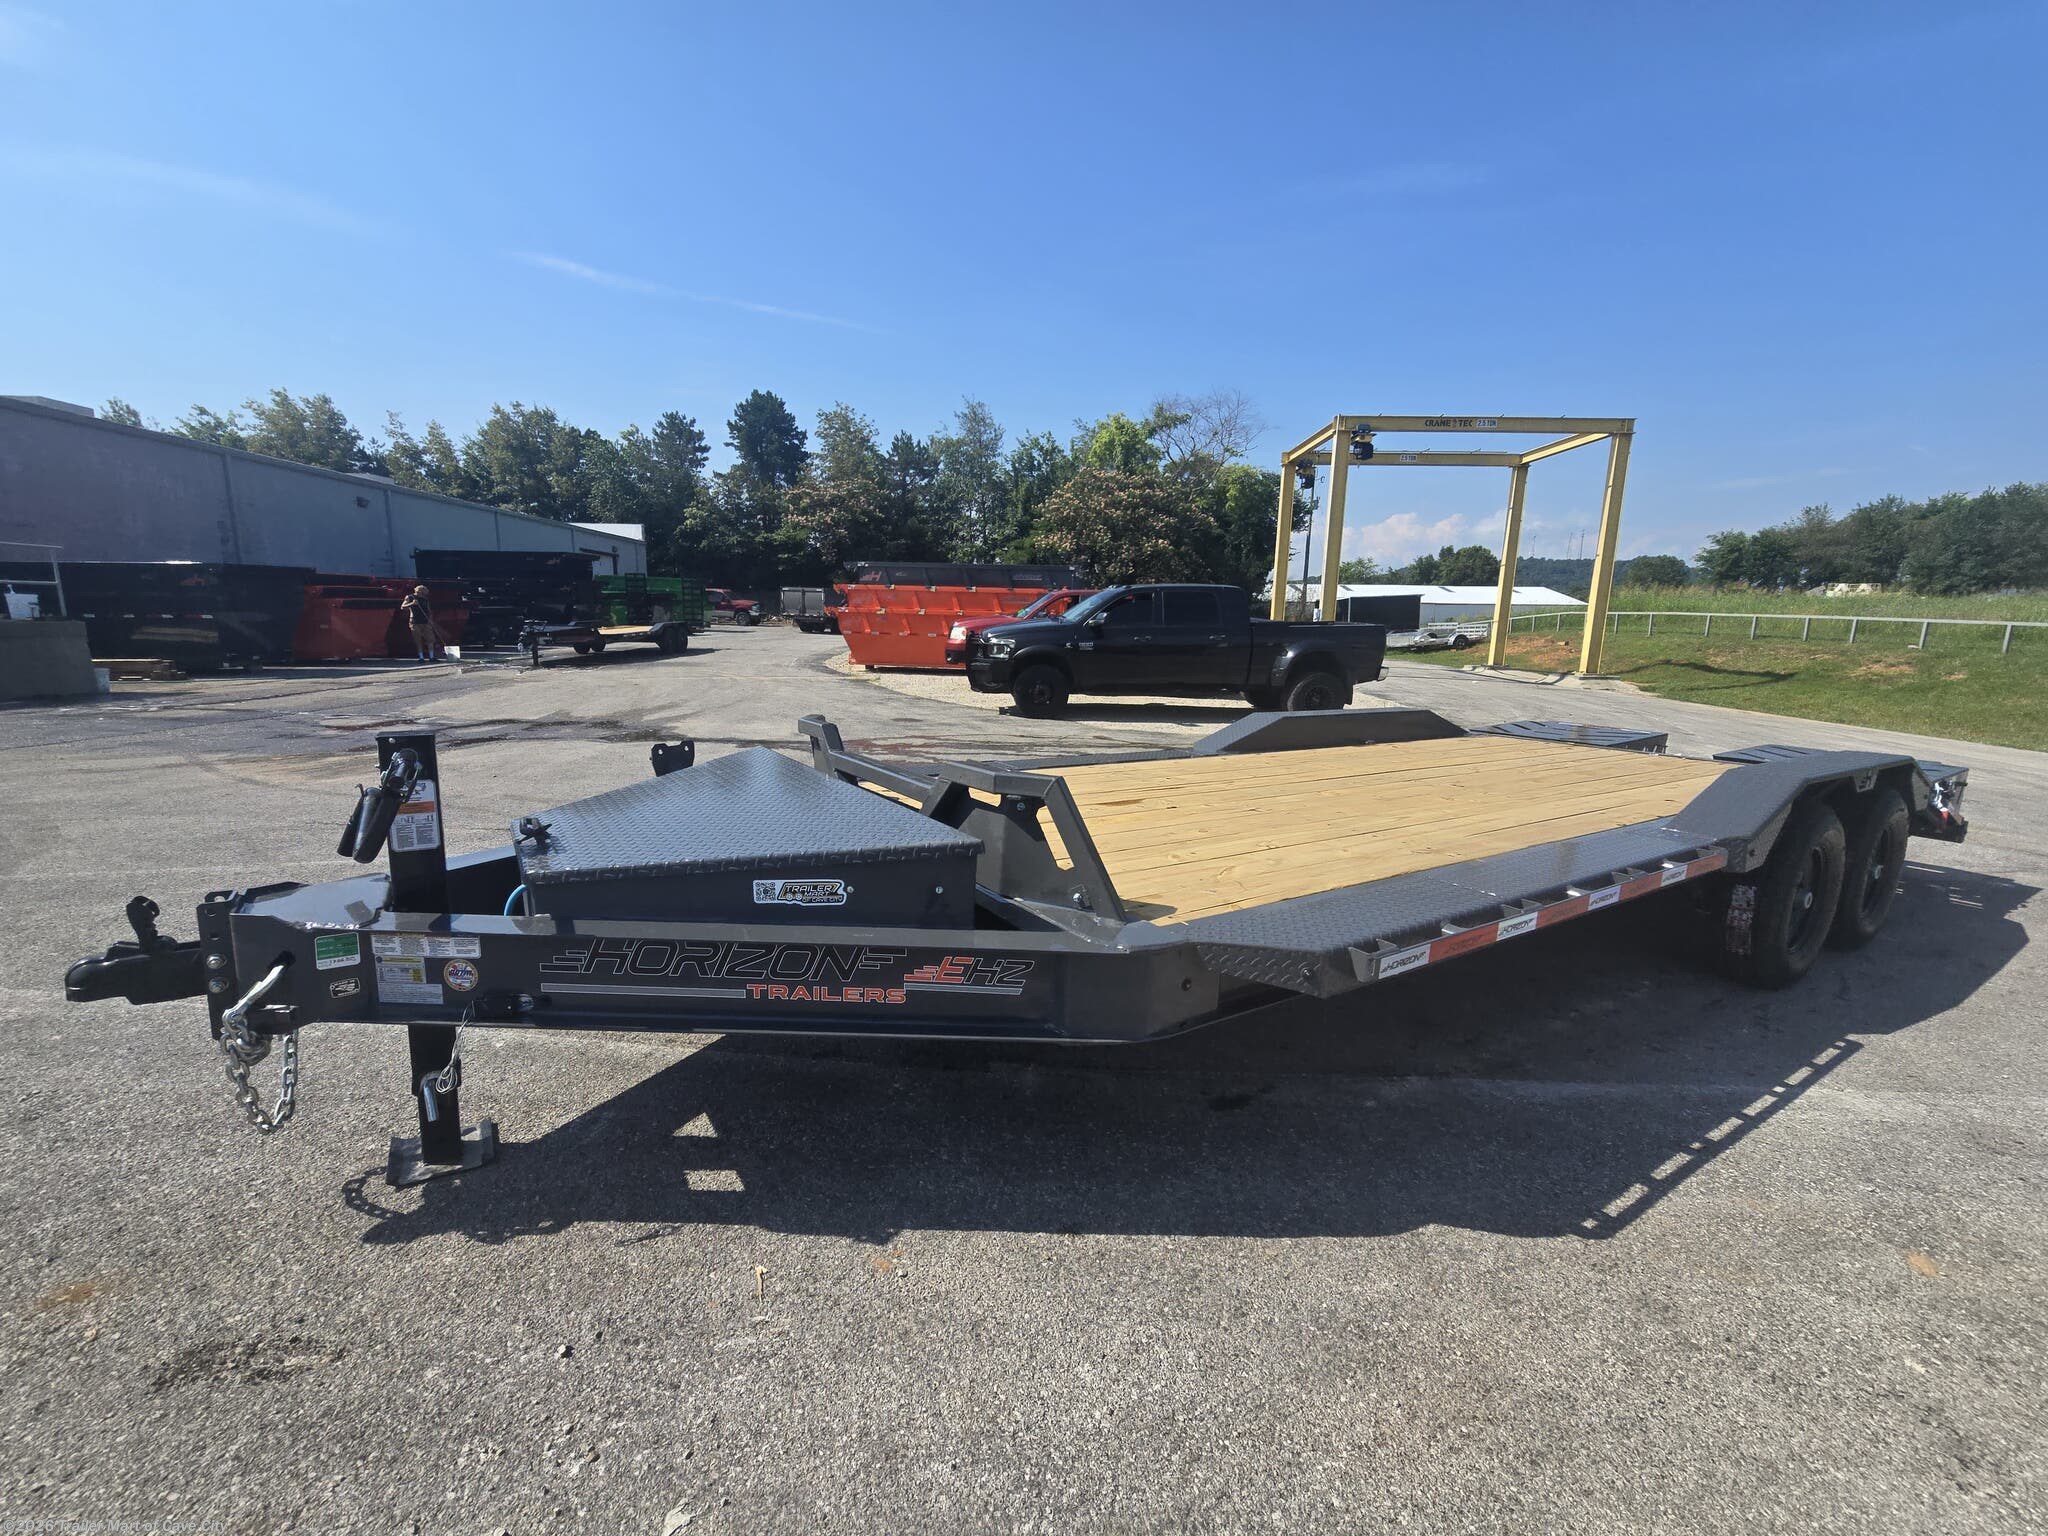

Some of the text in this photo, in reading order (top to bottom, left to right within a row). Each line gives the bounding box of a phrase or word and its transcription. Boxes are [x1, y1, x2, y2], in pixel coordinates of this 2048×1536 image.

[1424, 419, 1473, 427] CRANE TEC
[785, 885, 833, 893] TRAILER
[583, 937, 868, 982] HORIZON
[746, 983, 907, 1004] TRAILERS
